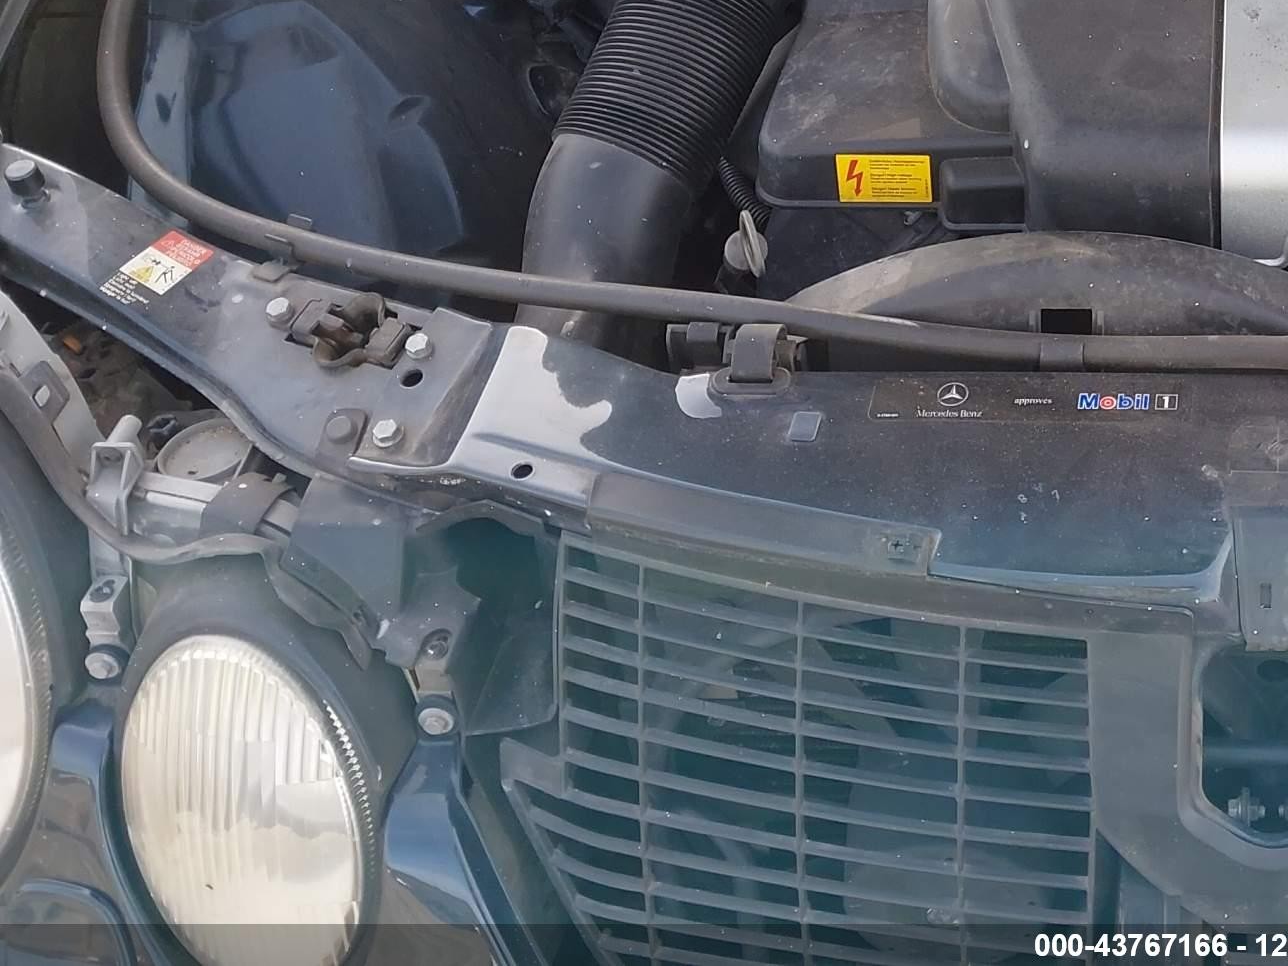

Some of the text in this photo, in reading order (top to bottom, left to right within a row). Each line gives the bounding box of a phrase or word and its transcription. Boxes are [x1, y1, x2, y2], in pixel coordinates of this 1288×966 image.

[1013, 396, 1053, 407] approves
[1077, 392, 1150, 411] Mobil
[915, 409, 983, 418] Mercedes Benz
